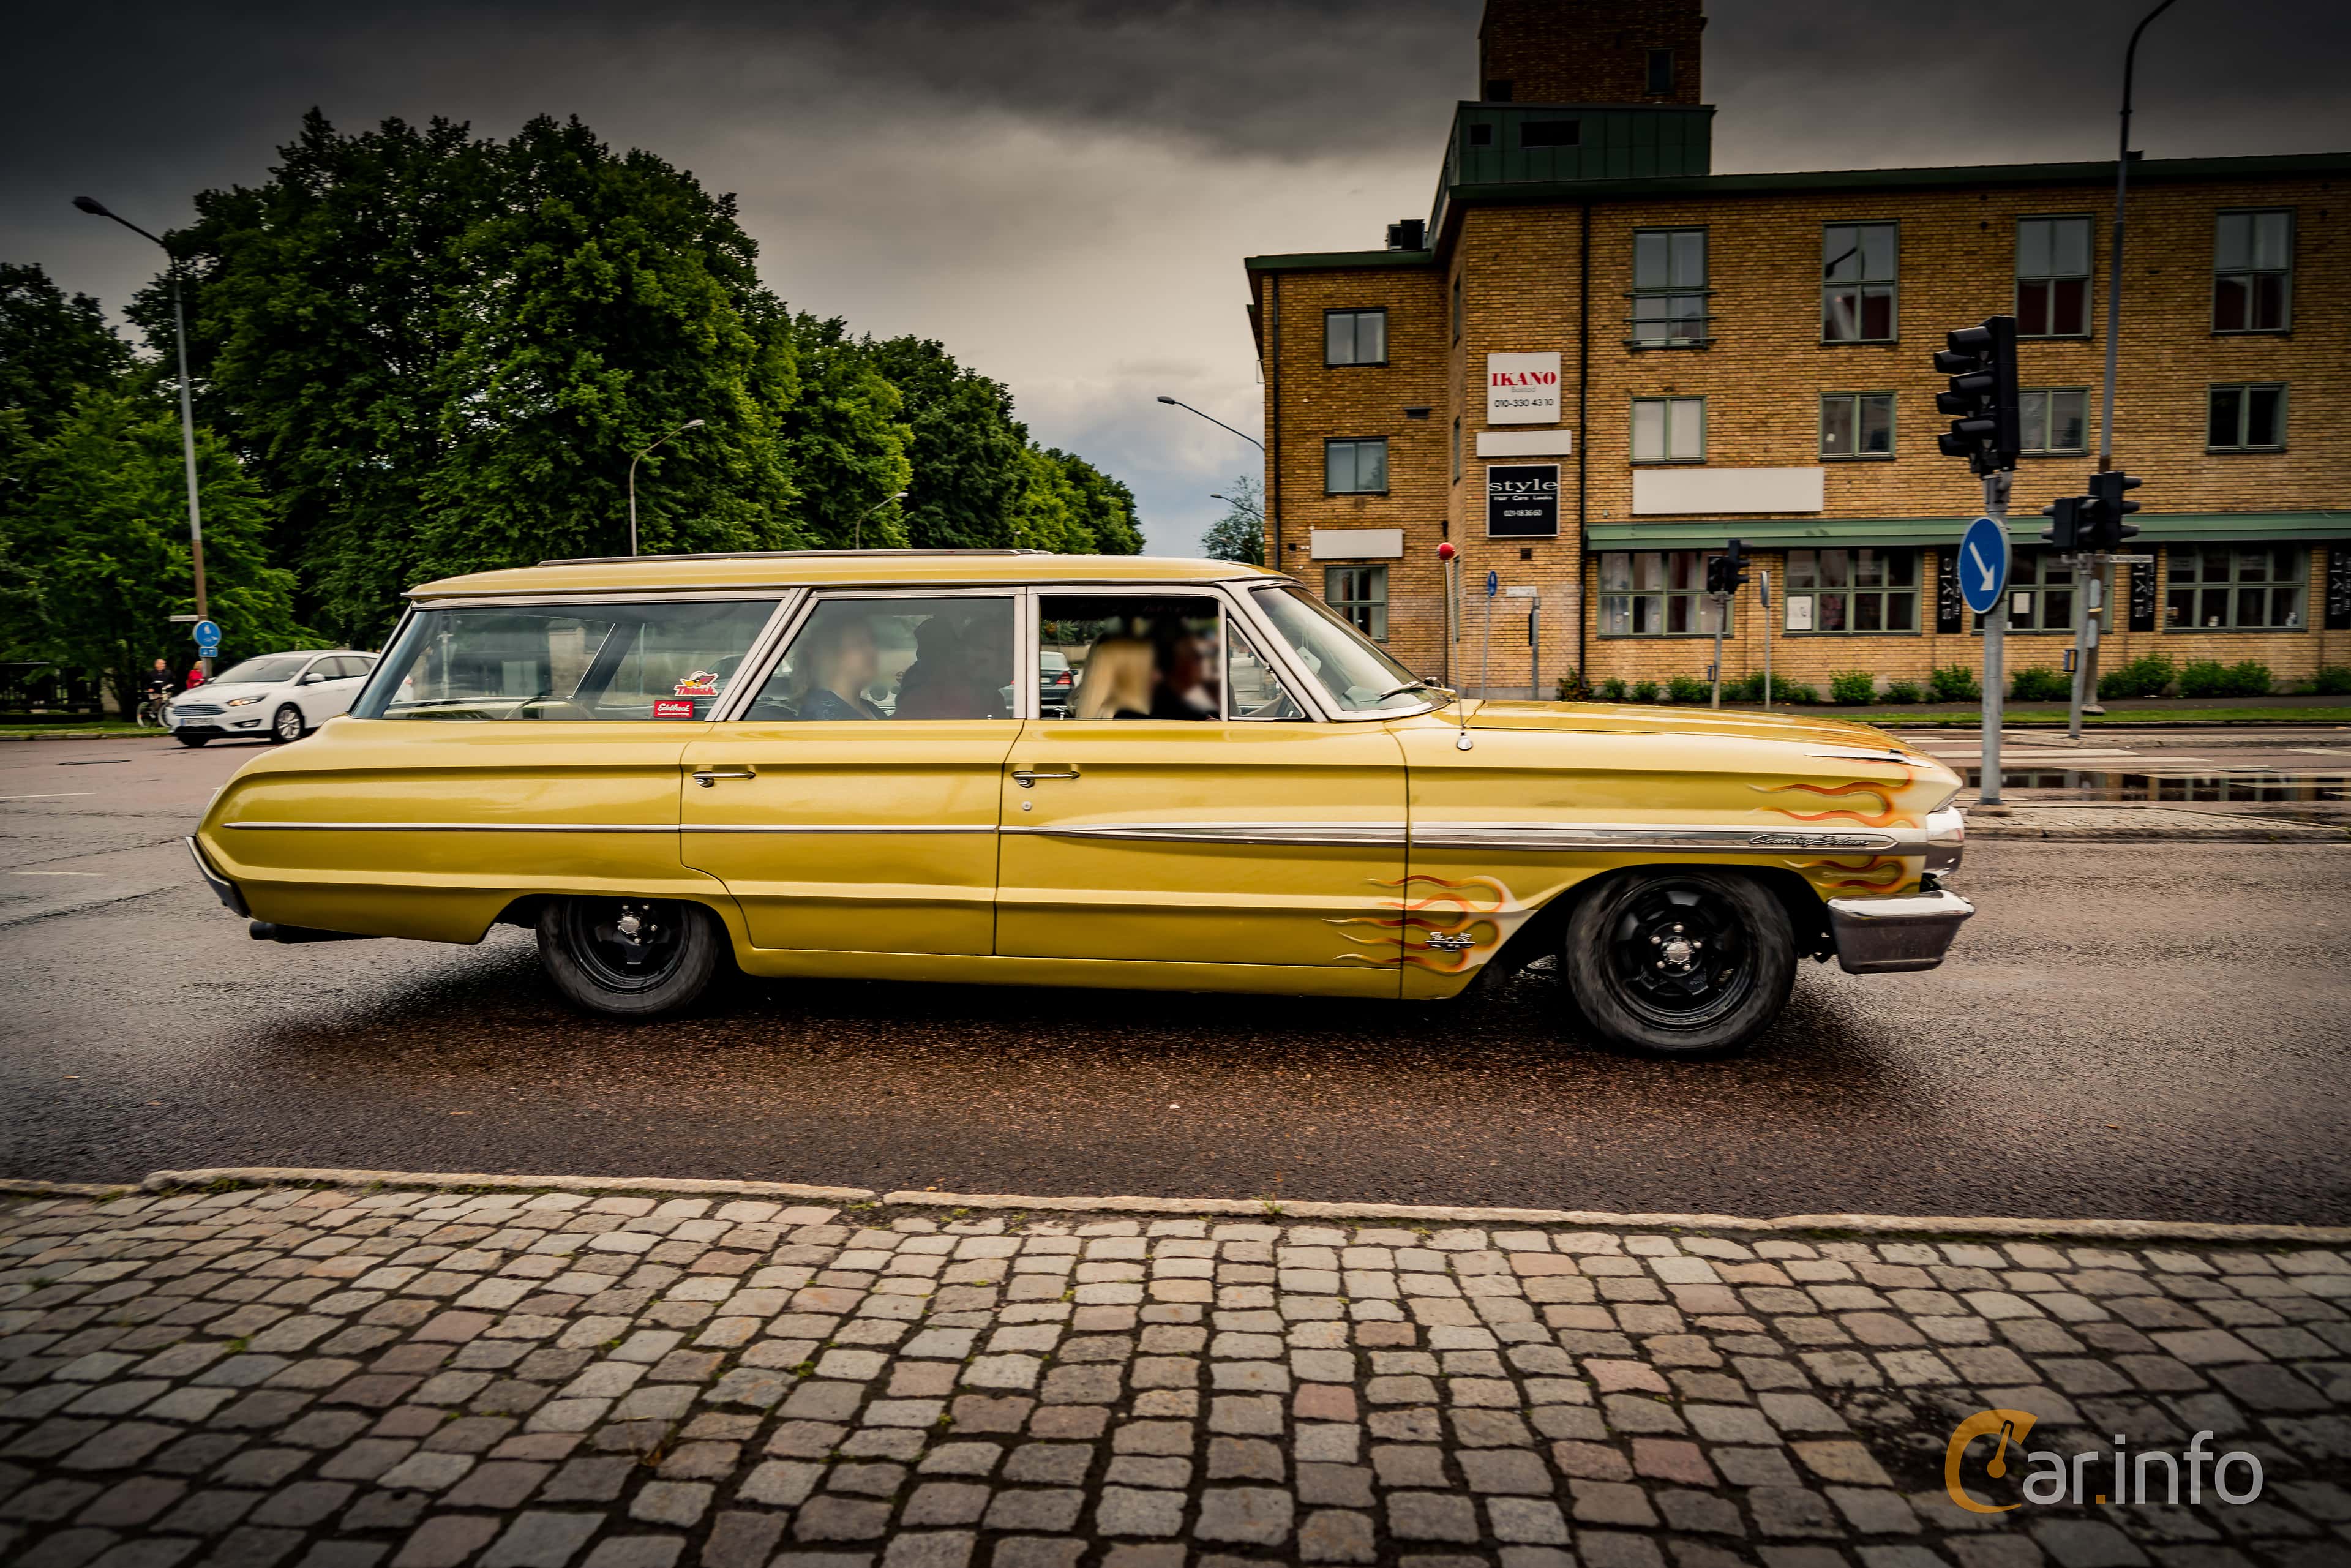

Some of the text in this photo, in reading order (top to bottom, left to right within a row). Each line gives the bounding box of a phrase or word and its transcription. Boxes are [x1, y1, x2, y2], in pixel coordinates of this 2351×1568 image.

[1492, 372, 1556, 386] IKANO
[1494, 399, 1529, 407] 010-330
[1490, 478, 1558, 493] style
[1748, 834, 1870, 847] Country Sedan
